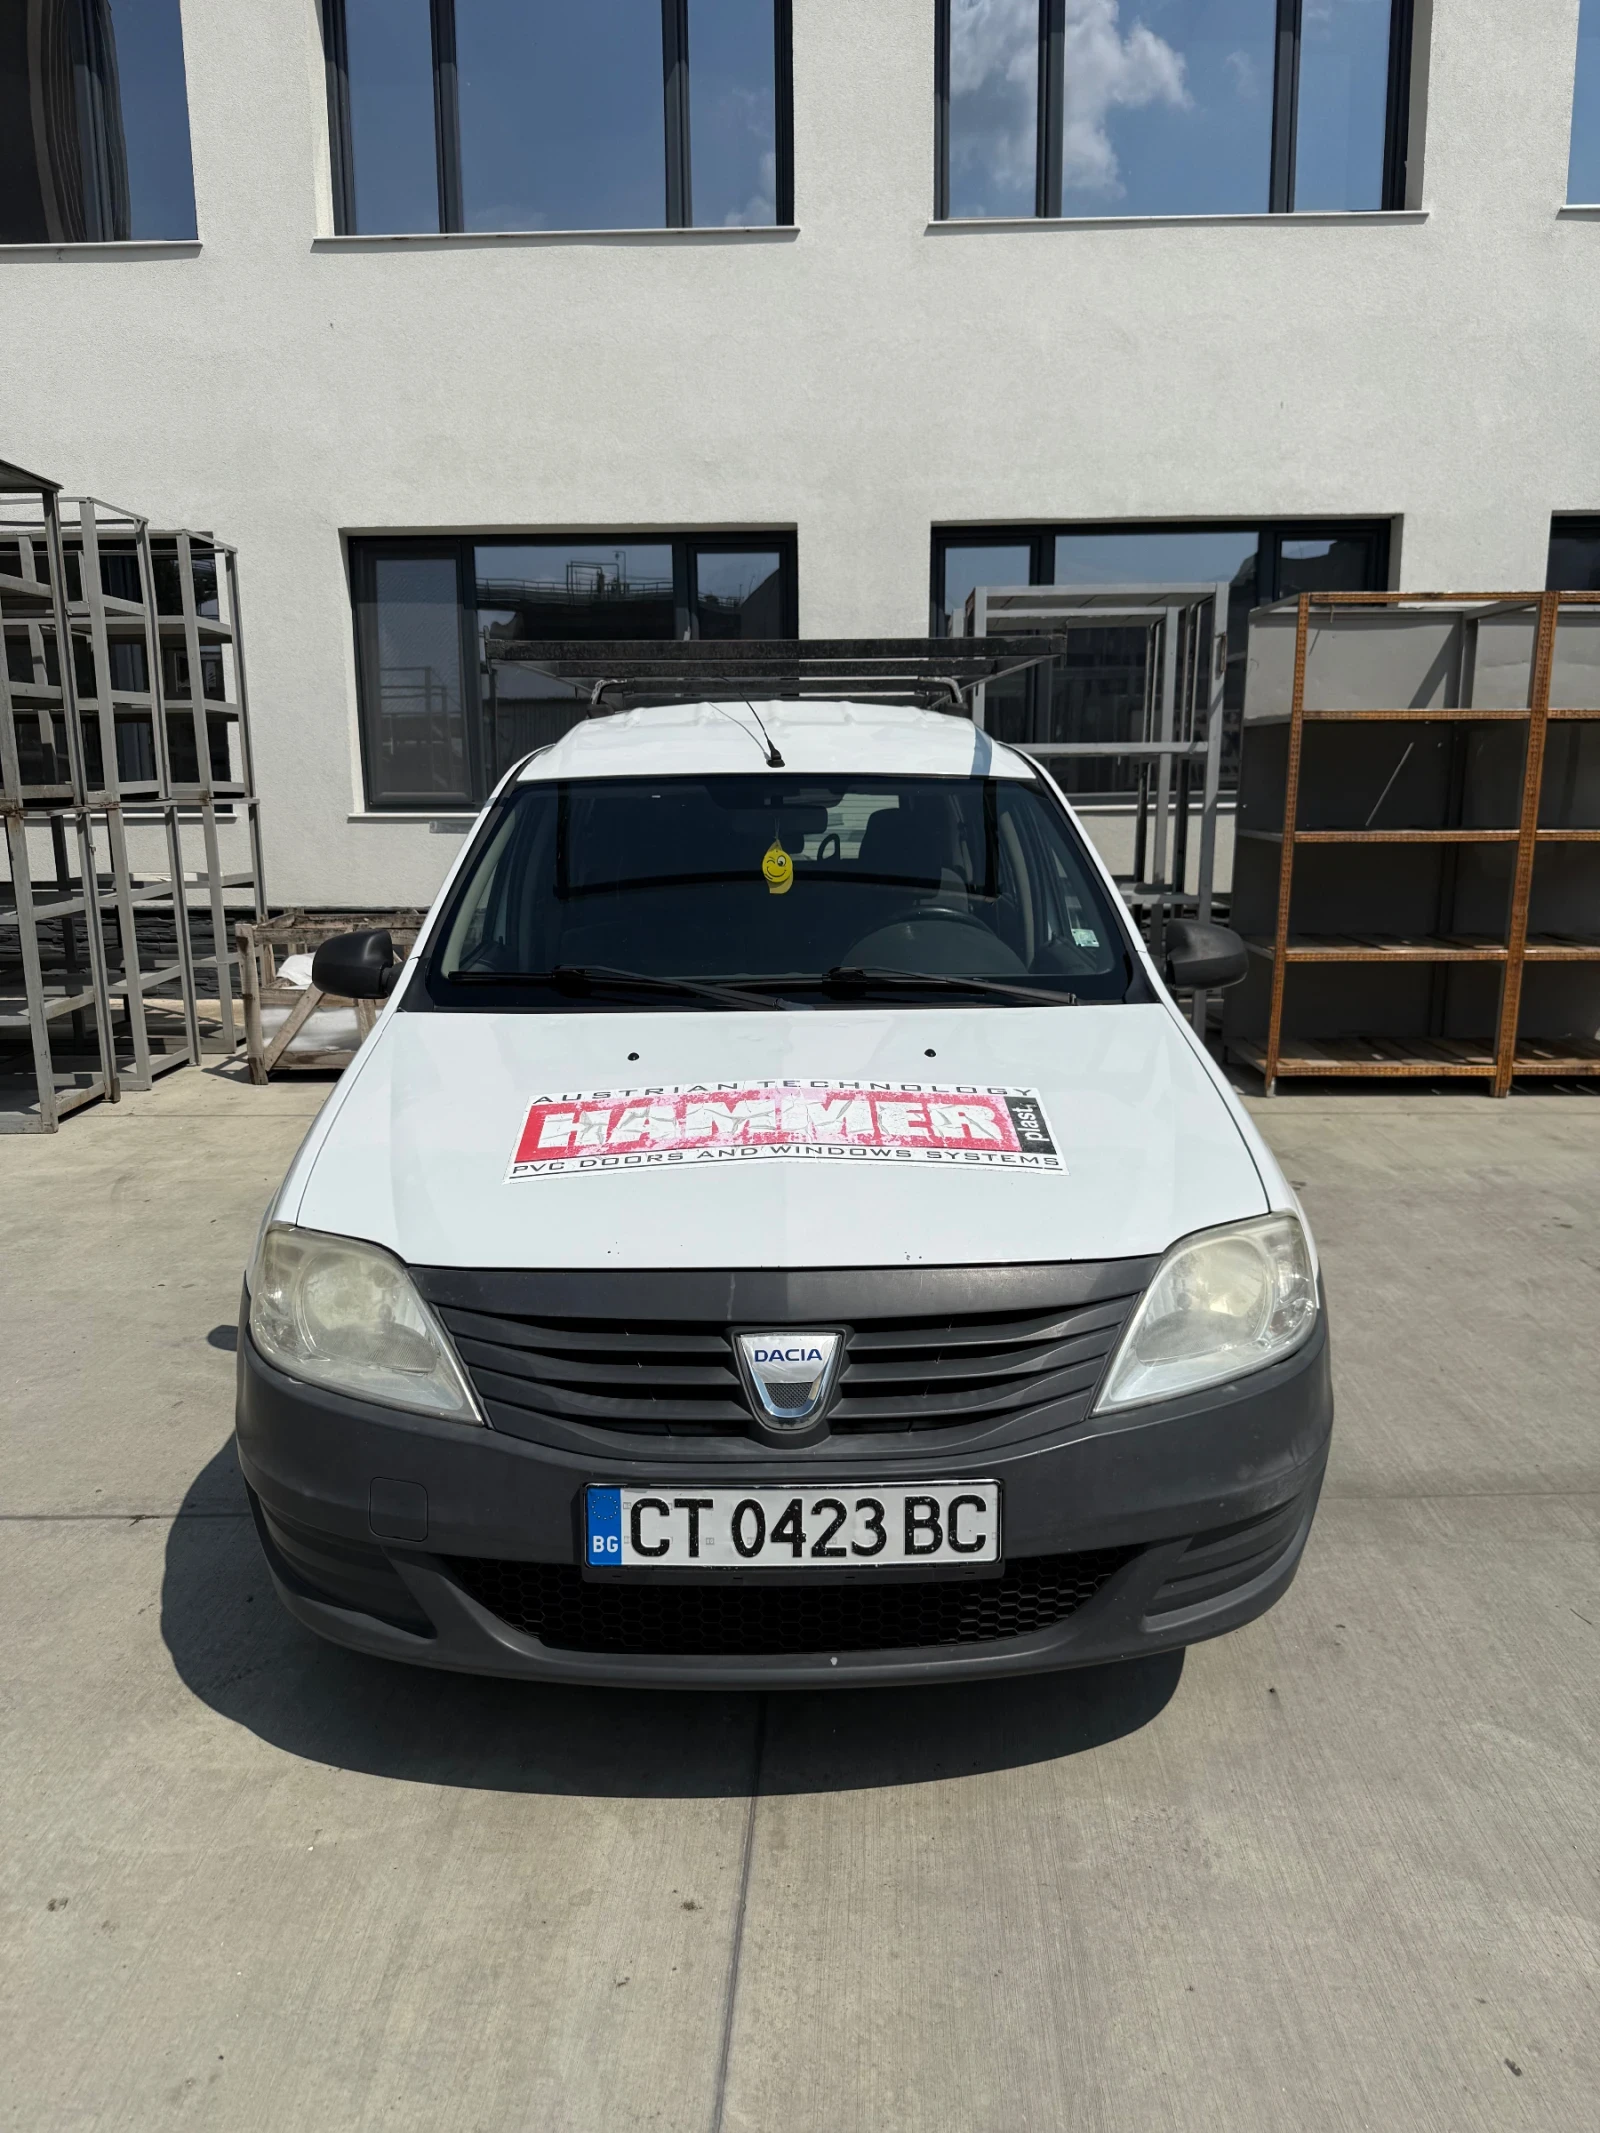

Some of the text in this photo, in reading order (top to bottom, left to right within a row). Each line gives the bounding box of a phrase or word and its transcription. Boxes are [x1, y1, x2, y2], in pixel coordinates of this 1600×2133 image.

[532, 1080, 1032, 1105] AUSTRIAN TECHNOLOGY
[537, 1097, 1003, 1149] HAMMER
[512, 1144, 1060, 1175] PVC DOORS AND WINDOWS SYSTEMS
[753, 1348, 823, 1363] DACIA
[630, 1494, 987, 1559] CT 0423 BC
[592, 1534, 619, 1553] BG
